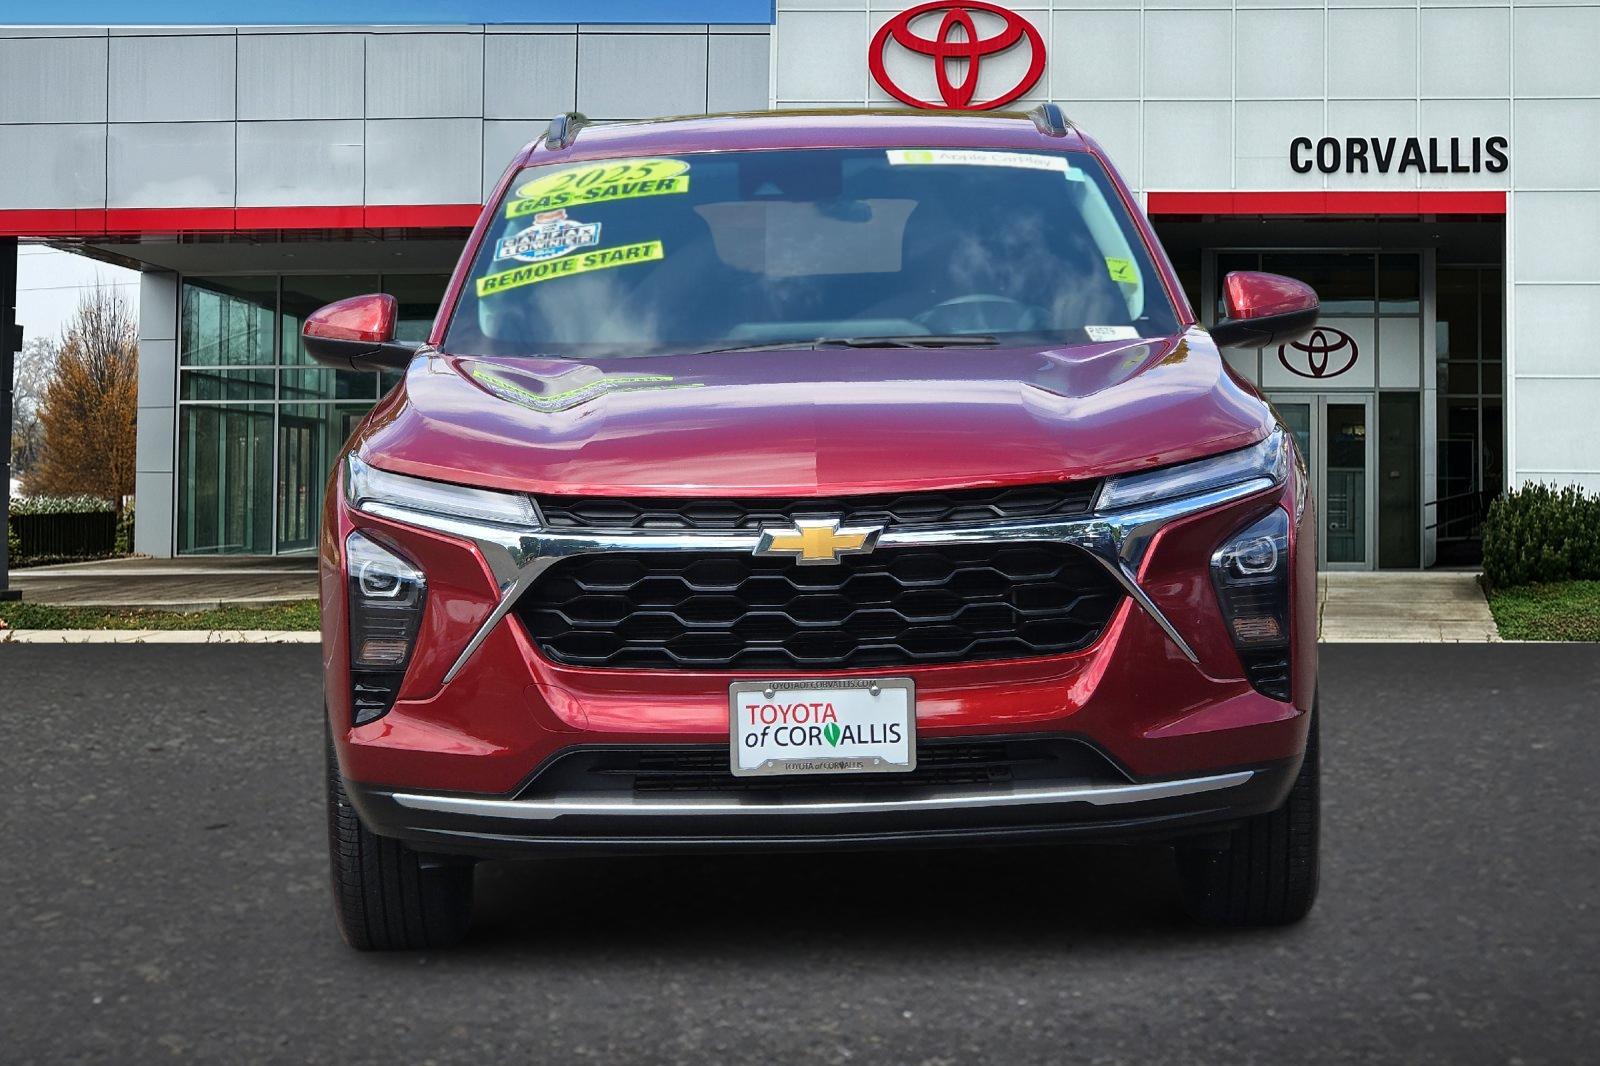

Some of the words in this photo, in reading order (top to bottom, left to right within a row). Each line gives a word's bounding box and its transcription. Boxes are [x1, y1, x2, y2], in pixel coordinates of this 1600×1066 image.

[1290, 136, 1509, 174] CORVALLIS
[547, 161, 662, 193] 2025
[514, 177, 677, 214] GAS-SAVER
[482, 259, 577, 292] REMOTE
[583, 244, 655, 268] START
[745, 702, 838, 726] TOYOTA
[744, 725, 771, 748] of
[785, 762, 814, 770] TOYOTA
